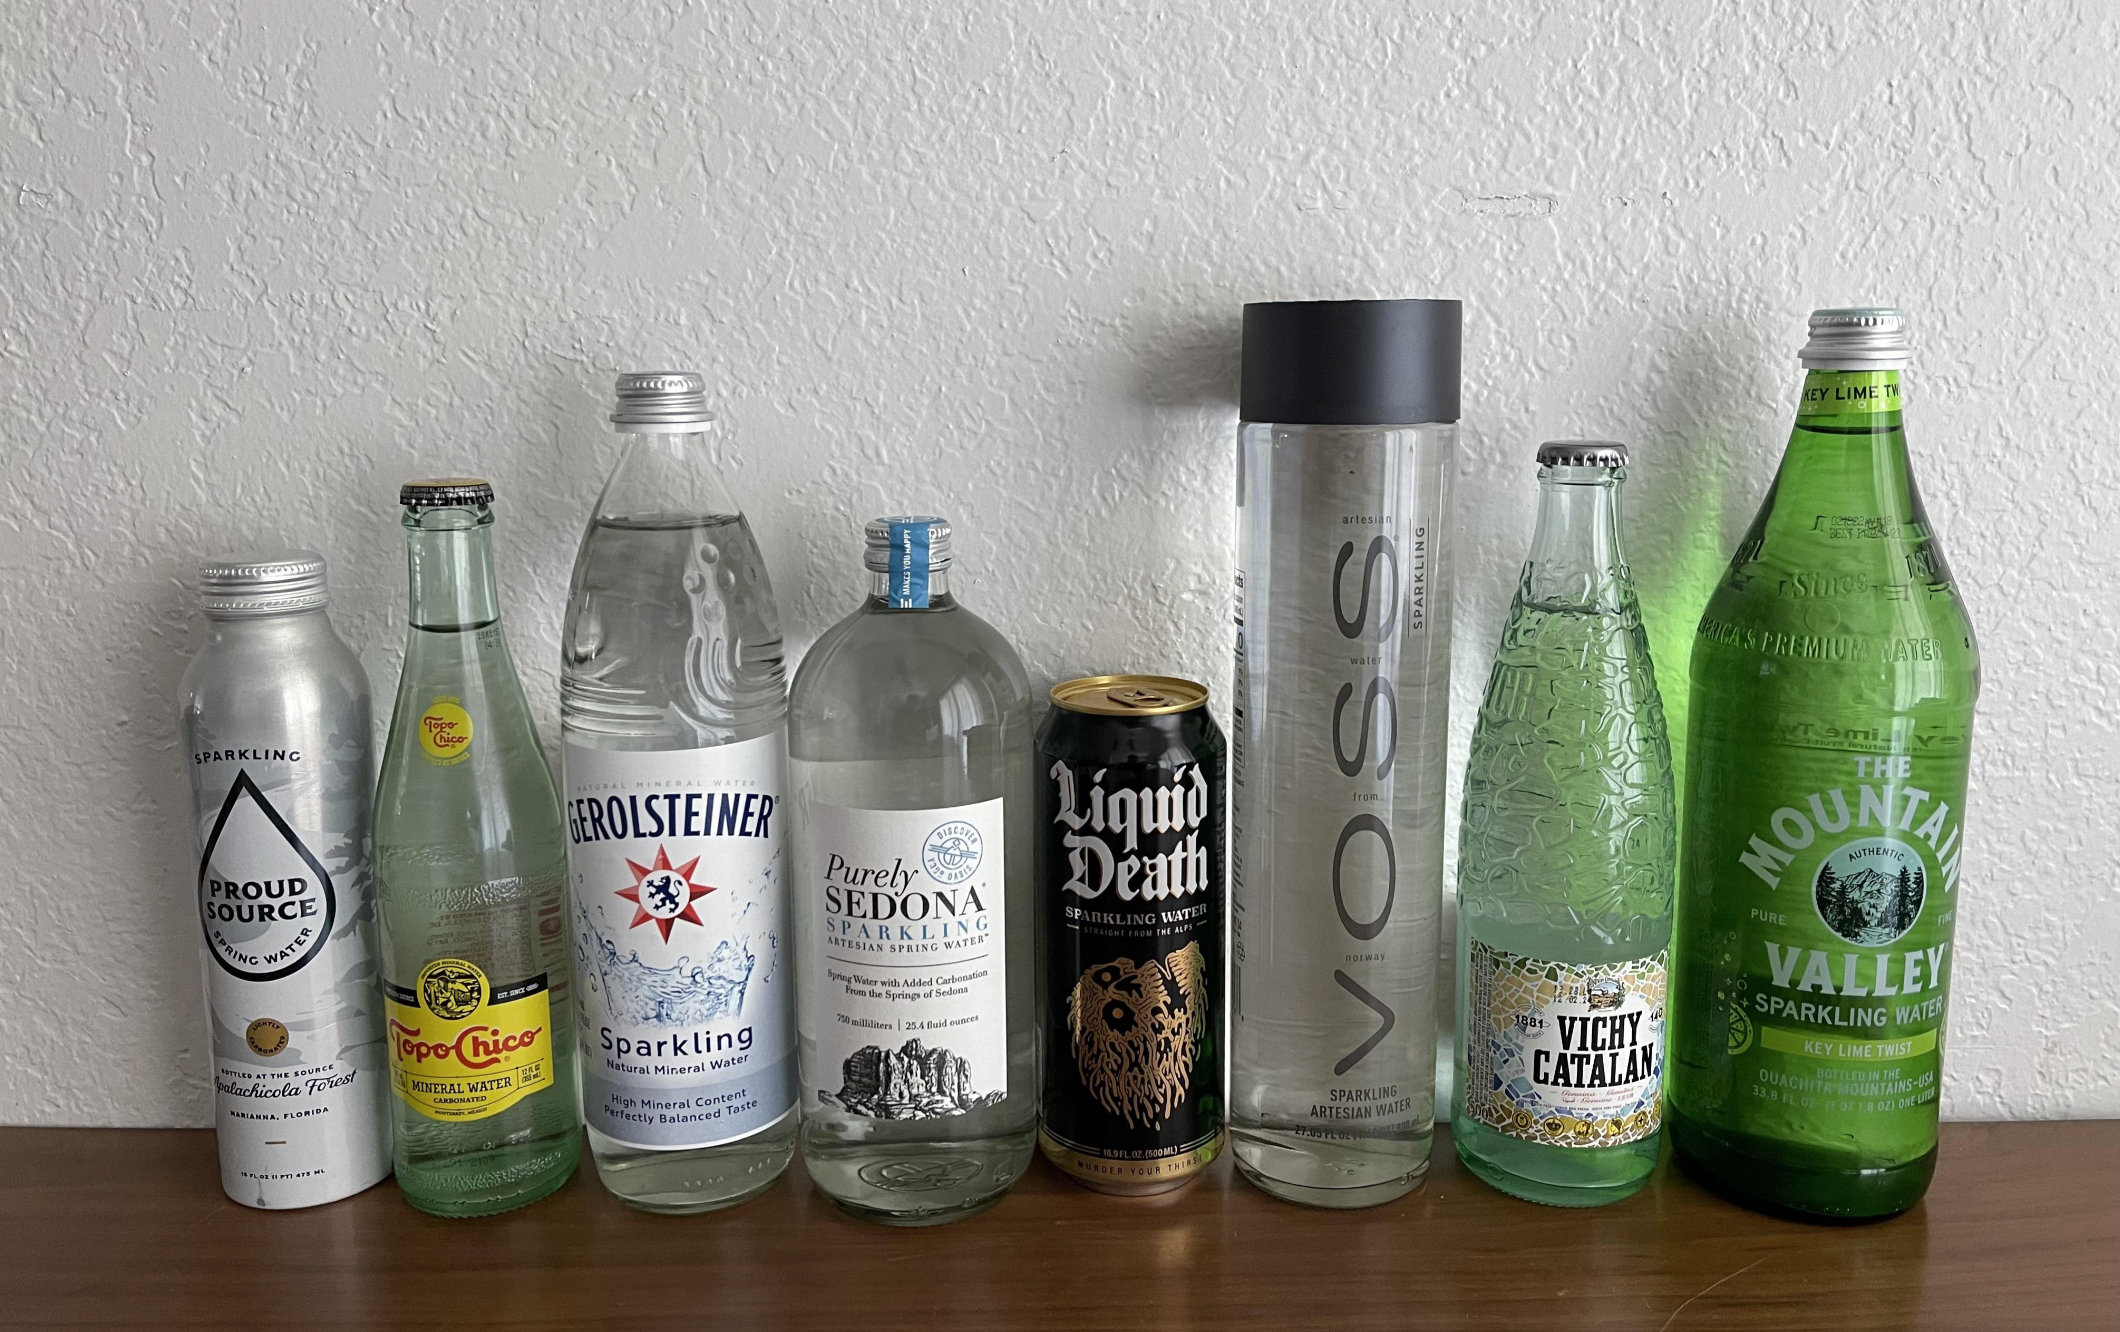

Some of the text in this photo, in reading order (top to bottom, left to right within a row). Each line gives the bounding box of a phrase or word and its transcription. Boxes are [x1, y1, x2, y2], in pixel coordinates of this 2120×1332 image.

[1804, 386, 1878, 401] KEY LIME
[1342, 514, 1392, 526] artesian
[902, 529, 912, 595] MAKES YOU HAPPY
[1413, 526, 1425, 630] SPARKLING
[1350, 655, 1383, 666] water
[423, 716, 459, 733] Topo
[433, 730, 468, 748] Chico
[195, 748, 301, 765] SPARKLING
[1853, 755, 1913, 778] THE
[577, 779, 756, 793] NATURAL MINERAL WATER
[1050, 759, 1208, 854] Liquid
[1332, 534, 1399, 1077] VOSS
[1353, 792, 1379, 802] from
[568, 793, 775, 845] GEROLSTEINER
[937, 826, 978, 845] DISCOVER
[1738, 784, 1961, 893] MOUNTAIN
[1848, 847, 1905, 862] AUTHENTIC
[947, 864, 973, 881] OASIS
[1061, 829, 1209, 901] Death
[823, 853, 919, 897] Purely
[209, 877, 308, 900] PROUD
[207, 897, 318, 923] SOURCE
[825, 885, 987, 922] SEDONA
[1065, 903, 1207, 925] SPARKLING WATER
[1751, 908, 1787, 926] PURE
[827, 915, 989, 941] SPARKLING
[1084, 923, 1193, 938] STRAIGHT FROM THE ALPS
[213, 927, 313, 965] SPRING WATER
[827, 935, 985, 953] ARTESIAN SPRING WATER
[1345, 951, 1386, 963] norway
[827, 968, 988, 988] Spring Water with Added Carbonation
[1764, 940, 1945, 997] VALLEY
[845, 985, 969, 1002] From the Springs of Sedona
[1755, 992, 1943, 1027] SPARKLING WATER
[252, 1021, 281, 1031] LIGHTLY
[836, 1014, 979, 1031] 750 milliliters 25.4 fluid ounces
[1515, 1013, 1544, 1030] 1881
[1556, 1010, 1643, 1050] VICHY
[249, 1035, 286, 1054] CARBONATED
[389, 1018, 543, 1070] Topo Chico
[600, 1025, 753, 1059] Sparkling
[1804, 1040, 1913, 1058] KEY LIME TWIST
[221, 1067, 252, 1080] BOTTLED
[294, 1063, 334, 1077] SOURCE
[606, 1053, 749, 1076] Natural Mineral Water
[1533, 1042, 1655, 1088] CATALAN
[305, 1068, 358, 1096] Forest
[1759, 1068, 1832, 1094] OUACHITA
[1817, 1068, 1901, 1081] BOTTLED IN THE
[411, 1079, 465, 1095] MINERAL
[467, 1076, 513, 1093] WATER
[1330, 1084, 1398, 1102] SPARKLING
[433, 1095, 487, 1104] CARBONATED
[611, 1088, 747, 1110] High Mineral Content
[1752, 1084, 1778, 1101] 33.8
[1878, 1099, 1895, 1112] OZ)
[1899, 1095, 1915, 1109] ONE
[1918, 1086, 1936, 1105] LITER
[230, 1106, 329, 1121] MARIANNA, FLORIDA
[604, 1099, 758, 1125] Perfectly Balanced Taste
[1310, 1097, 1411, 1120] ARTESIAN WATER
[1295, 1124, 1323, 1138] 27.05
[1077, 1159, 1123, 1176] MURDER
[1130, 1166, 1161, 1176] YOUR
